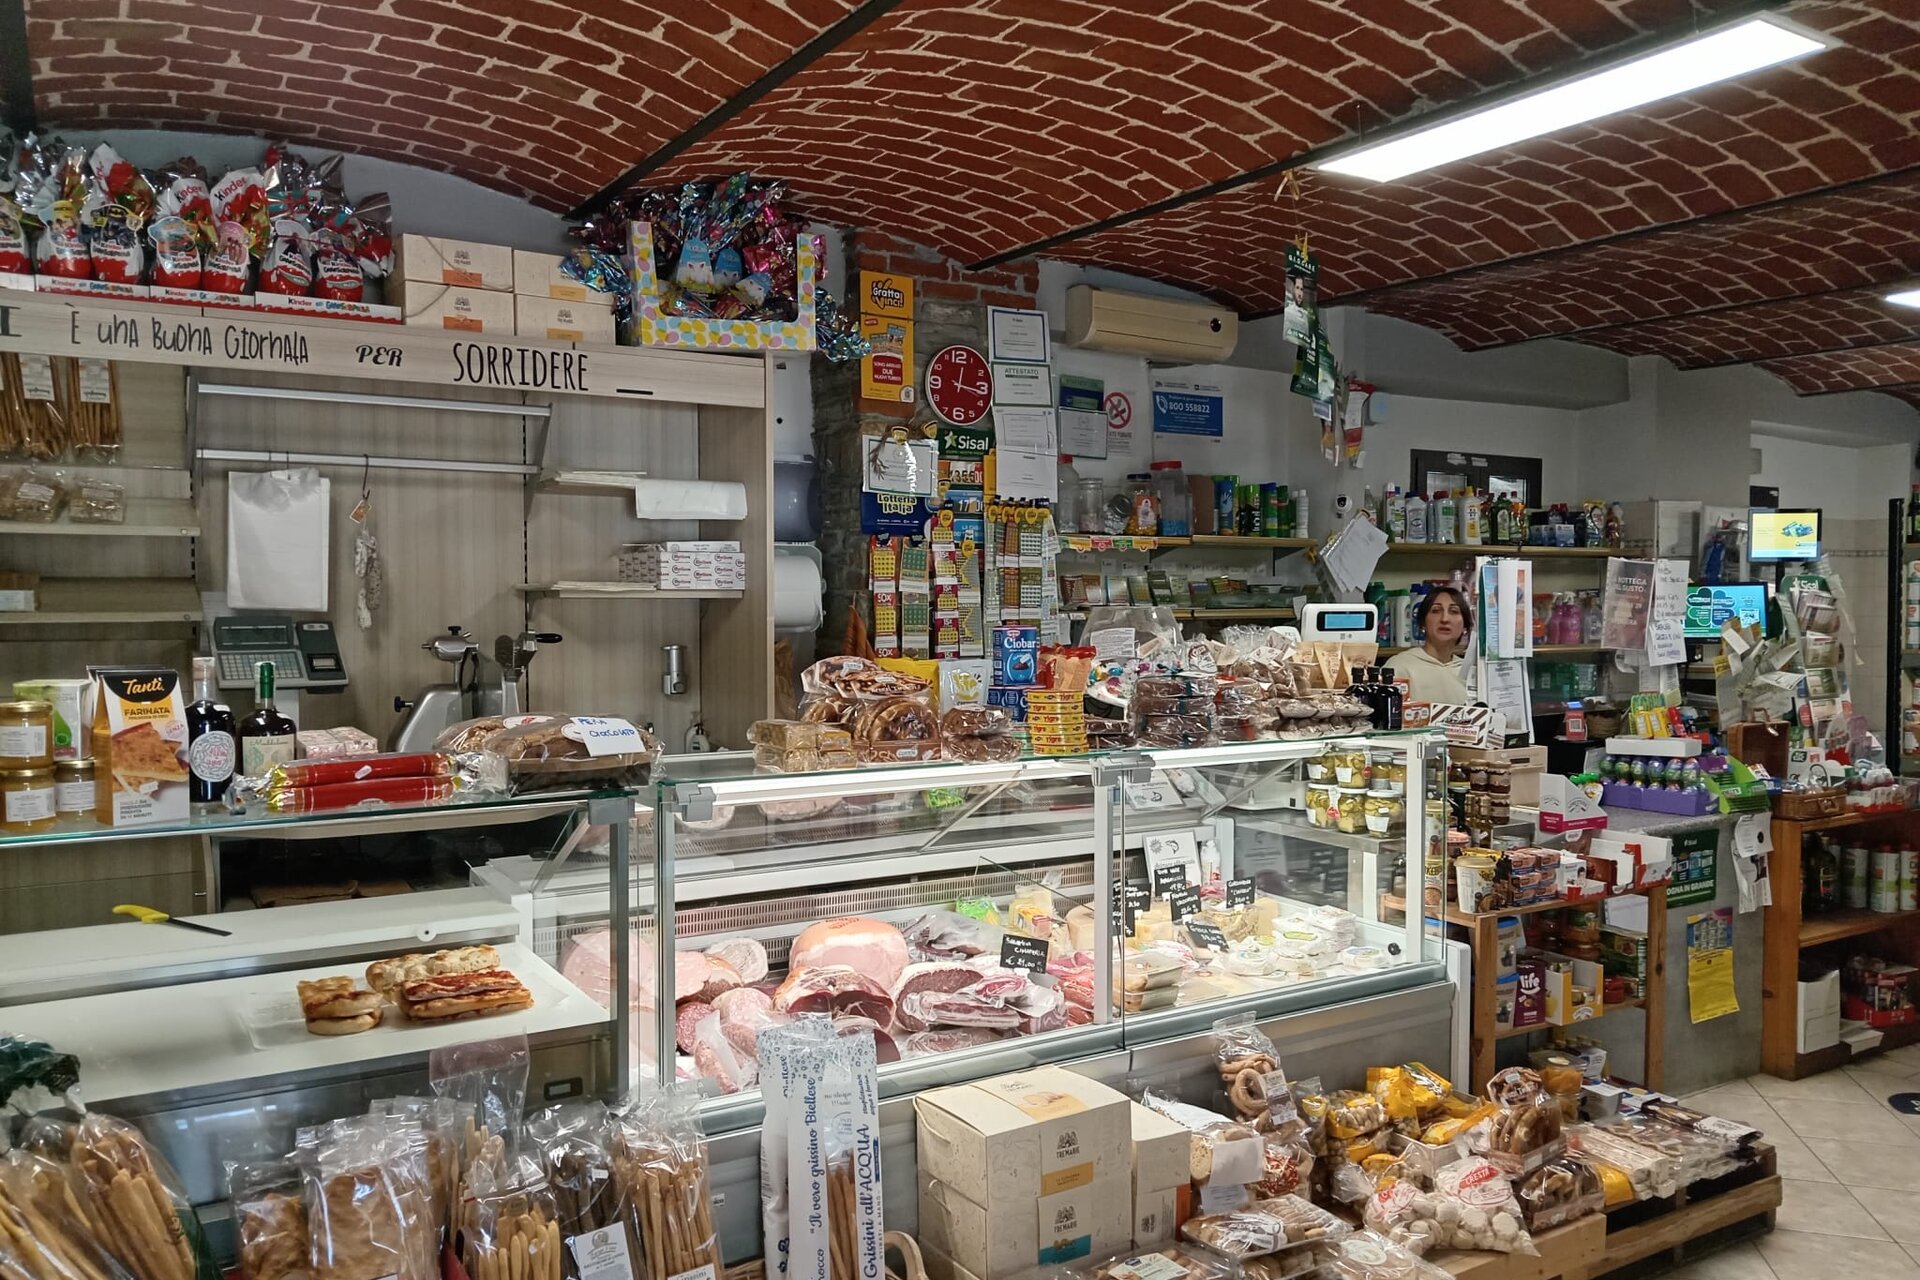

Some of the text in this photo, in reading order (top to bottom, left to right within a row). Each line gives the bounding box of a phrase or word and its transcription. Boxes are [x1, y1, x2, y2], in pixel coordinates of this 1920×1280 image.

[214, 176, 247, 201] Kinder
[872, 287, 901, 299] Gratta
[952, 350, 967, 364] 12
[453, 342, 589, 392] SORRIDERE
[978, 369, 984, 377] 2
[1005, 367, 1039, 376] ATTESTATO
[930, 375, 941, 389] 9
[976, 381, 988, 394] 3
[942, 406, 948, 414] 7
[1169, 402, 1184, 411] 800
[952, 407, 964, 420] 6
[968, 410, 975, 418] 5
[958, 435, 989, 450] Sisal
[877, 493, 917, 505] Lotteria
[883, 502, 914, 515] Italia
[1004, 637, 1036, 649] Ciobar
[1666, 885, 1683, 896] OGNA
[1520, 972, 1540, 988] life
[807, 1128, 825, 1177] grissino
[811, 1181, 821, 1211] vero
[862, 1220, 877, 1278] Grissini
